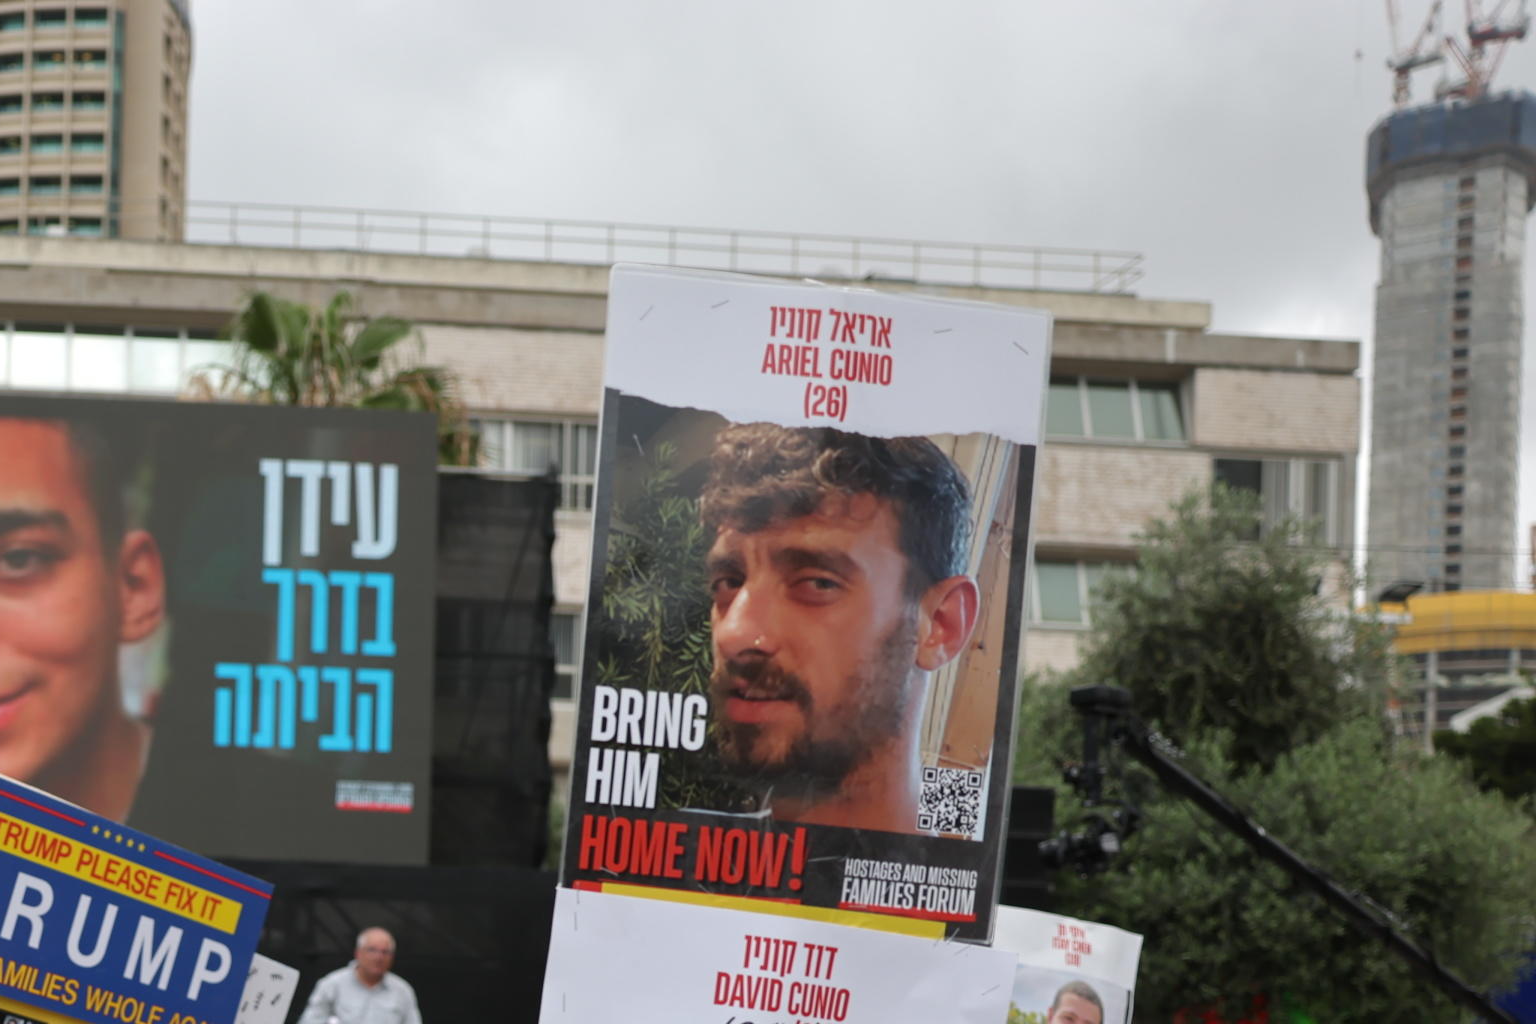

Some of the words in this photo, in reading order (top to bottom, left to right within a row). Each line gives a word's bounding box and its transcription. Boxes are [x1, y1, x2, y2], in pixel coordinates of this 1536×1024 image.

[770, 306, 822, 343] קוניו
[829, 308, 892, 349] אריאל
[761, 343, 823, 378] ARIEL
[829, 348, 893, 386] CUNIO
[804, 382, 848, 423] (26)
[259, 458, 399, 566] עידן
[261, 567, 397, 662] בדרך
[214, 662, 394, 753] הביתה
[590, 685, 708, 751] BRING
[585, 747, 660, 809] HIM
[579, 814, 688, 878] HOME
[694, 825, 807, 891] NOW!
[844, 857, 902, 882] HOSTAGES
[903, 864, 927, 884] AND
[927, 866, 978, 889] MISSING
[75, 848, 162, 899] PLEASE
[164, 883, 197, 914] FIX
[199, 897, 223, 922] IT
[841, 877, 915, 910] FAMILIES
[917, 884, 976, 917] FORUM
[744, 934, 797, 977] קוניו
[803, 943, 839, 980] דוד
[713, 971, 783, 1013] DAVID
[787, 981, 850, 1022] CUNIO
